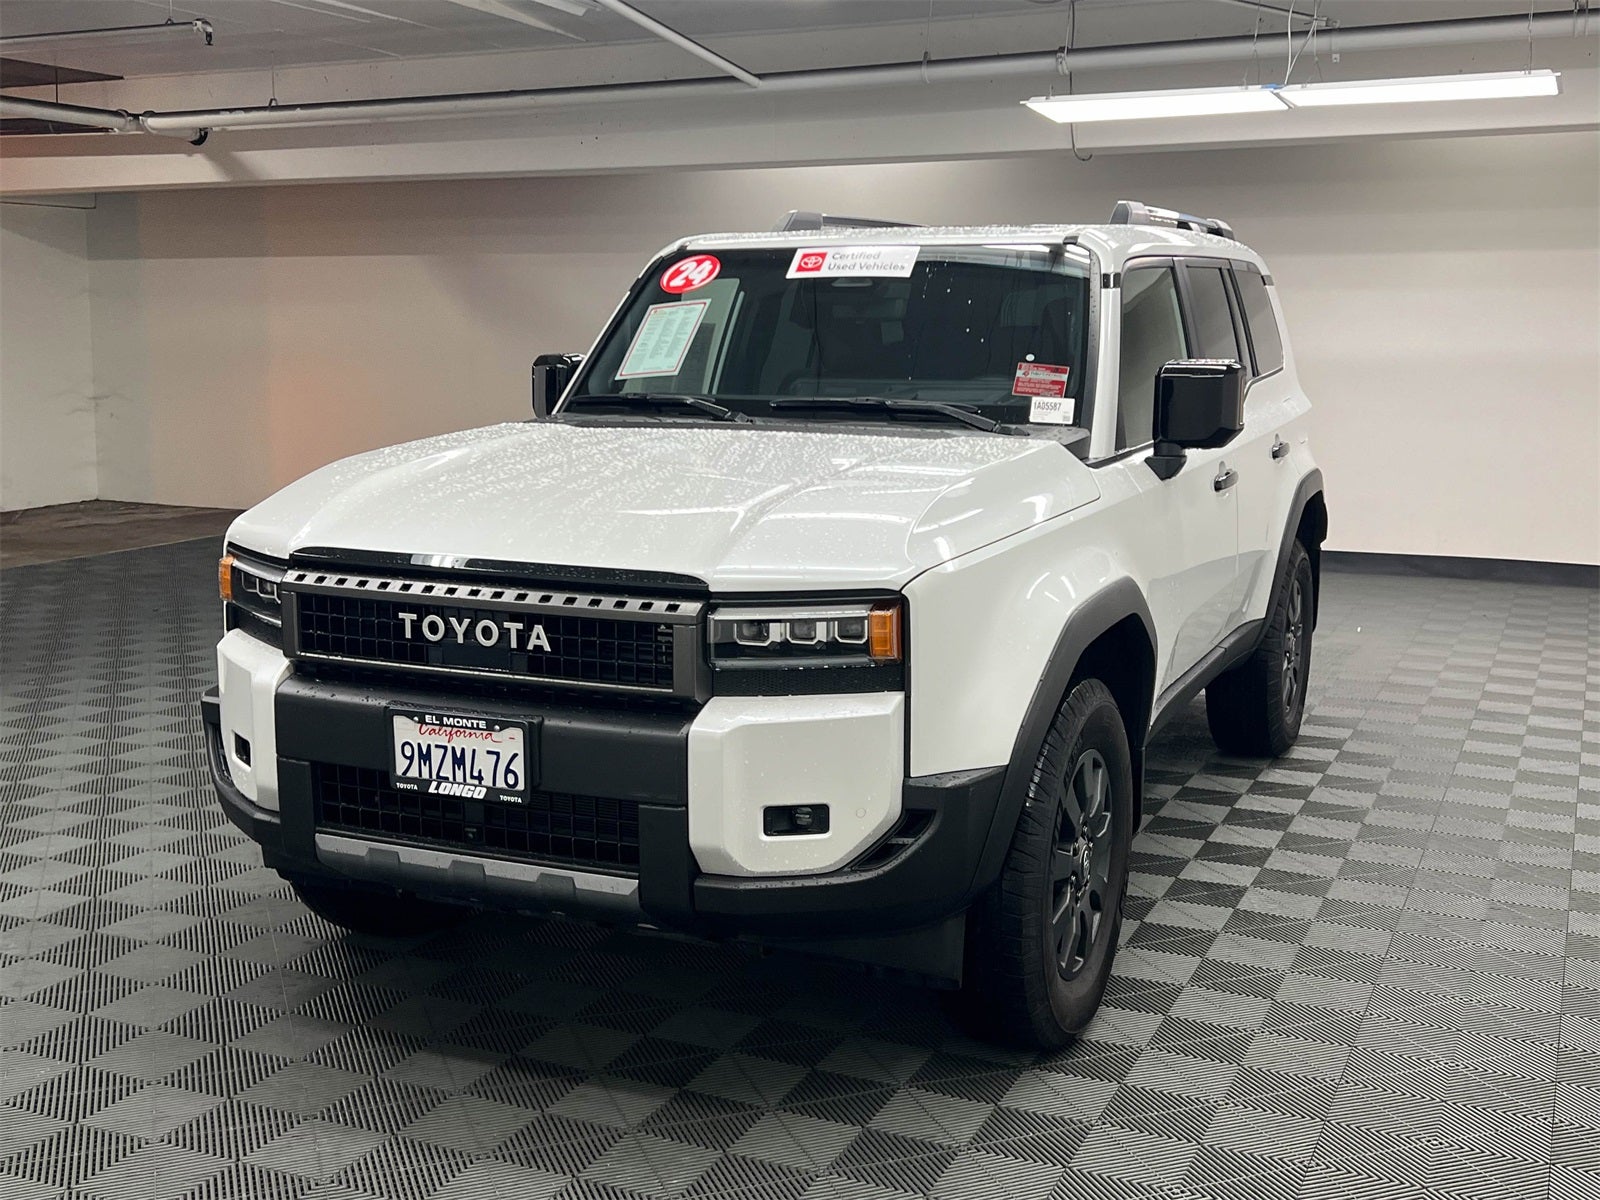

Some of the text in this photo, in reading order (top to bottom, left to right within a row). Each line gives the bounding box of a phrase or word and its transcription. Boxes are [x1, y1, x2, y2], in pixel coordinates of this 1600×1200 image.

[832, 251, 881, 260] Certified
[669, 259, 713, 287] 24
[828, 262, 906, 271] Used Vehicles
[398, 612, 552, 652] TOYOTA
[425, 715, 487, 729] EL MONTE
[418, 723, 503, 743] California
[401, 741, 519, 789] 9MZM476
[396, 782, 418, 790] TOYOTA
[428, 781, 487, 799] LONGO
[499, 795, 522, 803] TOYOTA
